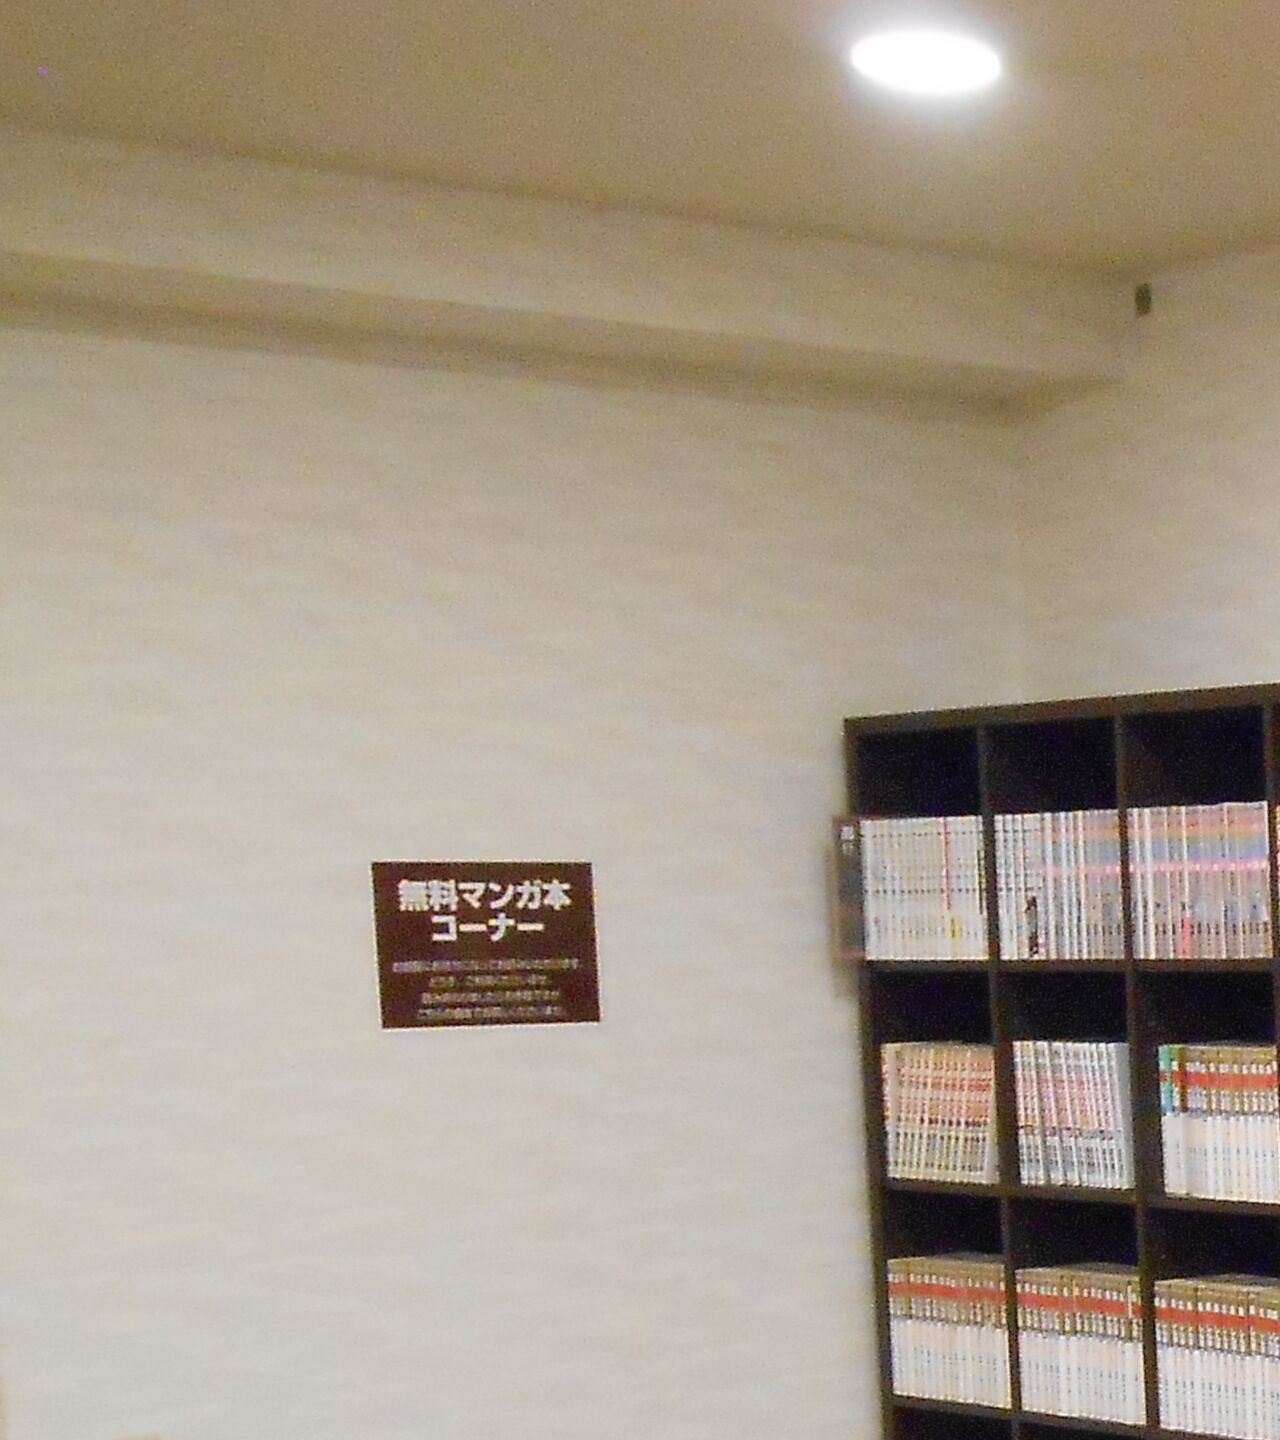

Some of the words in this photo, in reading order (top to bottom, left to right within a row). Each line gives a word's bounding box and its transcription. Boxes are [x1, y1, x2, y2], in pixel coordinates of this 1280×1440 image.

[397, 879, 571, 911] 無料マンガ本
[431, 913, 543, 941] コーナー
